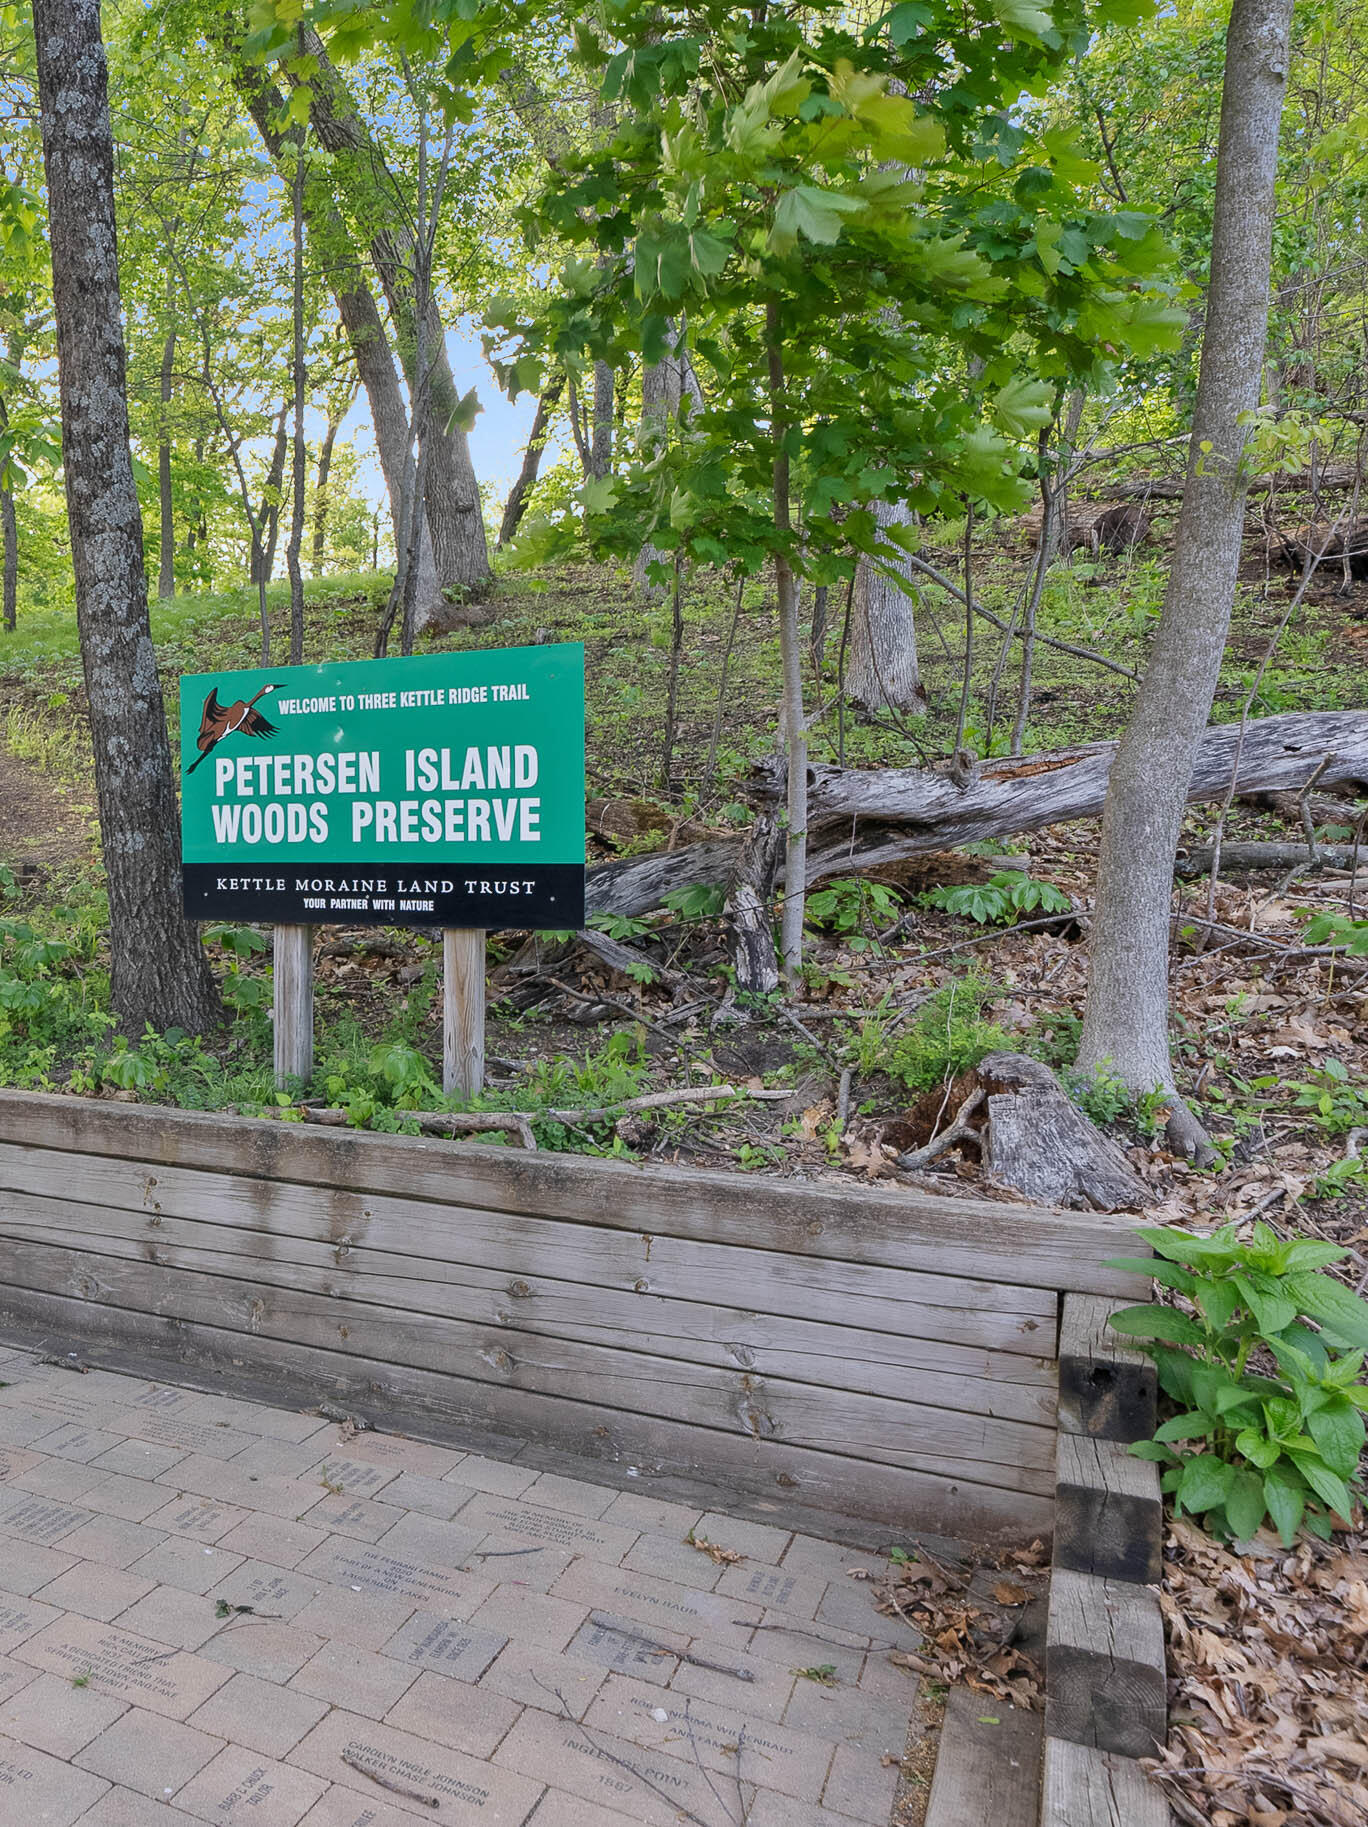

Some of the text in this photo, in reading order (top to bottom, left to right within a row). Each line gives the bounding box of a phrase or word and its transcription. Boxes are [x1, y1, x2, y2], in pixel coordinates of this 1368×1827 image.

[278, 684, 529, 714] WELCOME TO THREE KETTLE RIDGE TRAIL
[216, 745, 538, 796] PETERSEN ISLAND
[212, 798, 540, 843] WOODS PRESERVE
[217, 879, 535, 894] KETTLE MORAINE LAND TRUST
[304, 898, 434, 911] YOUR PARTNER WITH NATURE
[382, 1570, 405, 1580] NEW
[406, 1578, 462, 1598] GENERATION
[614, 1587, 659, 1604] EVELYN
[107, 1634, 161, 1656] IN MEMORY
[44, 1646, 178, 1698] SERVED OUR TOWN AND LAKE
[69, 1646, 118, 1668] DEDICATED
[118, 1664, 152, 1680] FRIEND
[155, 1676, 177, 1688] THAT
[73, 1665, 132, 1690] COMMUNITY
[697, 1734, 741, 1751] FAM
[17, 1769, 33, 1780] ED
[342, 1748, 486, 1807] WALKER CHASE JOHNSON
[349, 1741, 490, 1798] CAROLYN INGLE JOHNSON
[644, 1768, 689, 1788] POINT
[218, 1791, 242, 1812] BARB
[242, 1767, 268, 1789] CHUCK
[246, 1783, 275, 1807] TAYLOR
